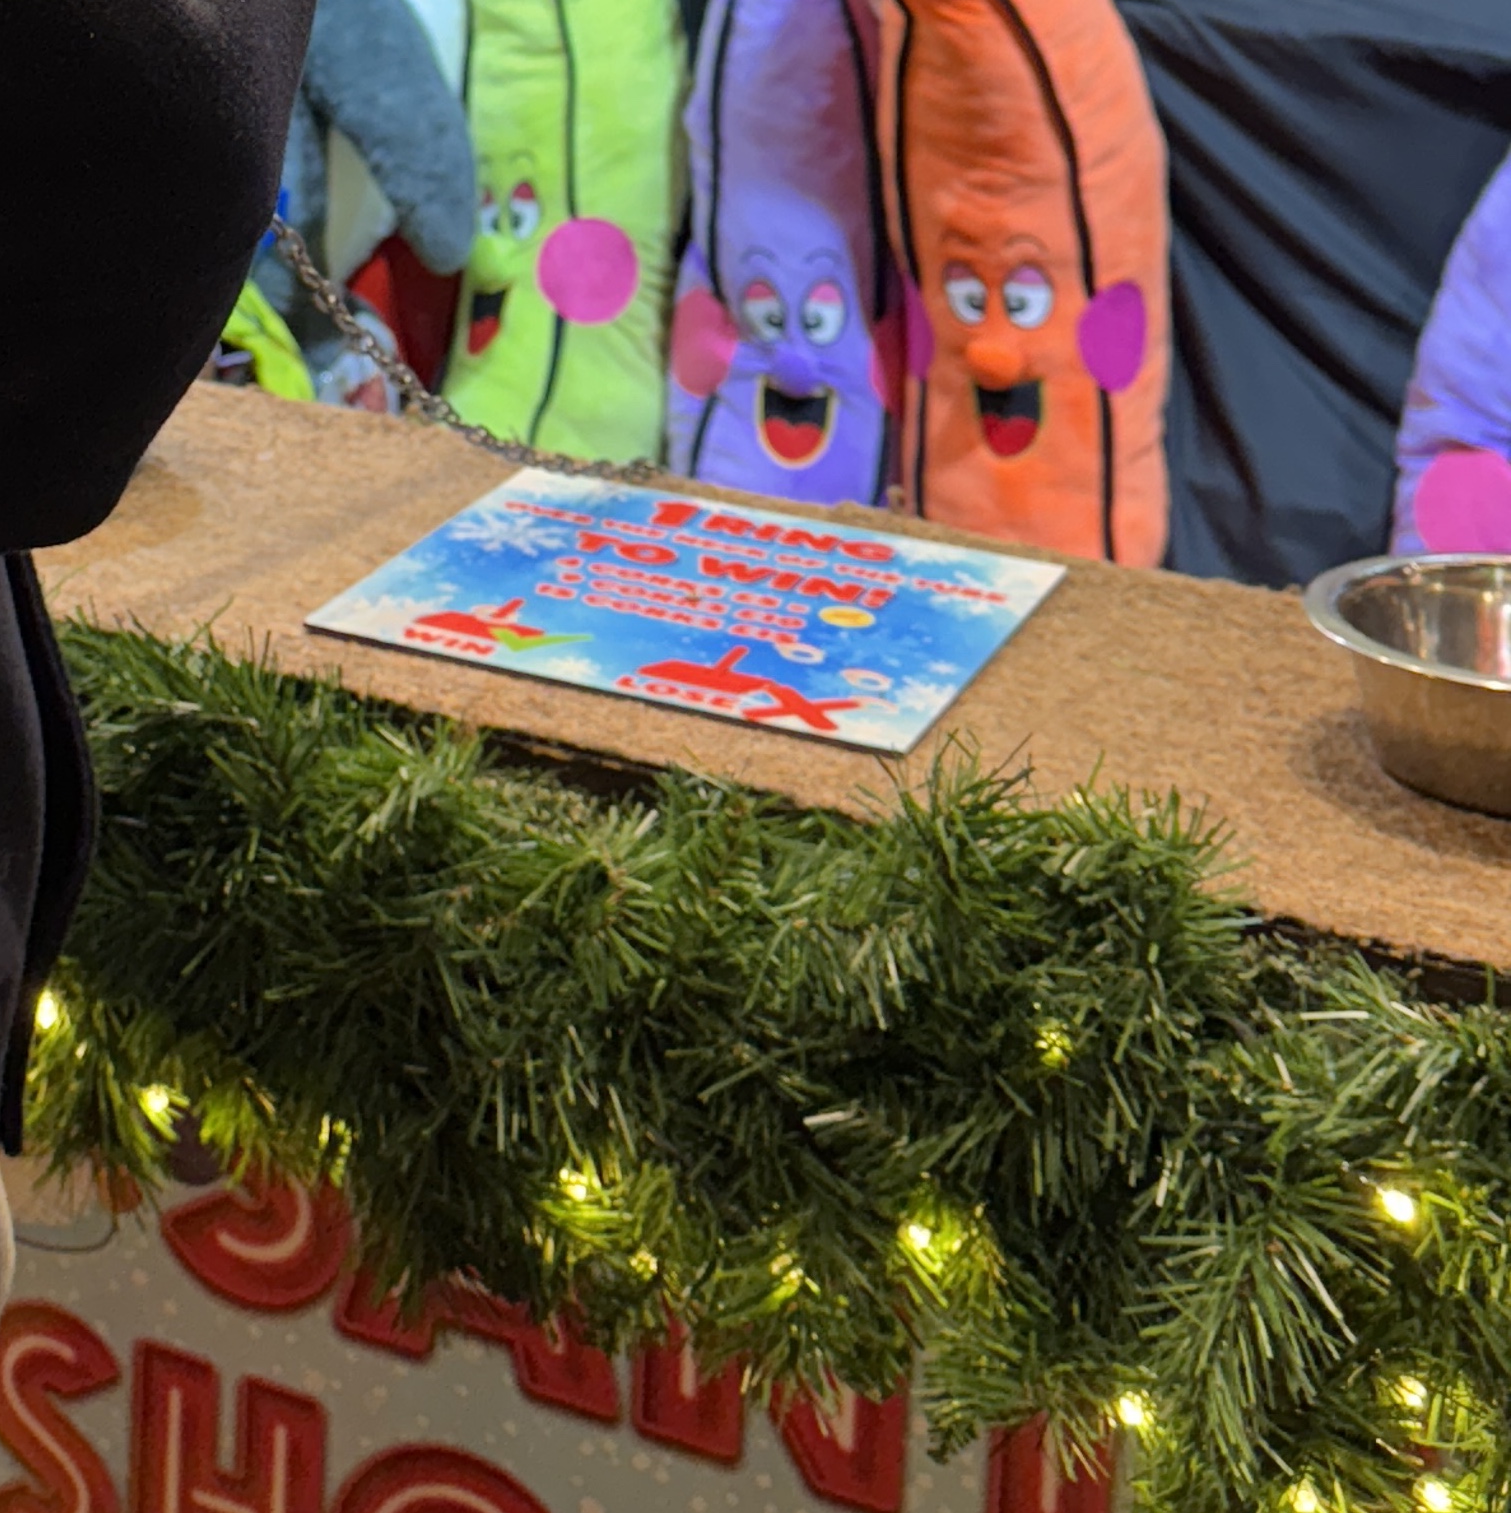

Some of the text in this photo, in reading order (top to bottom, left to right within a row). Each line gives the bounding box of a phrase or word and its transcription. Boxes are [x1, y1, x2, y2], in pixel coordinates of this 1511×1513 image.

[575, 529, 896, 609] TO WIN!
[649, 500, 896, 563] 1 RING
[402, 626, 738, 710] WIN LOSE
